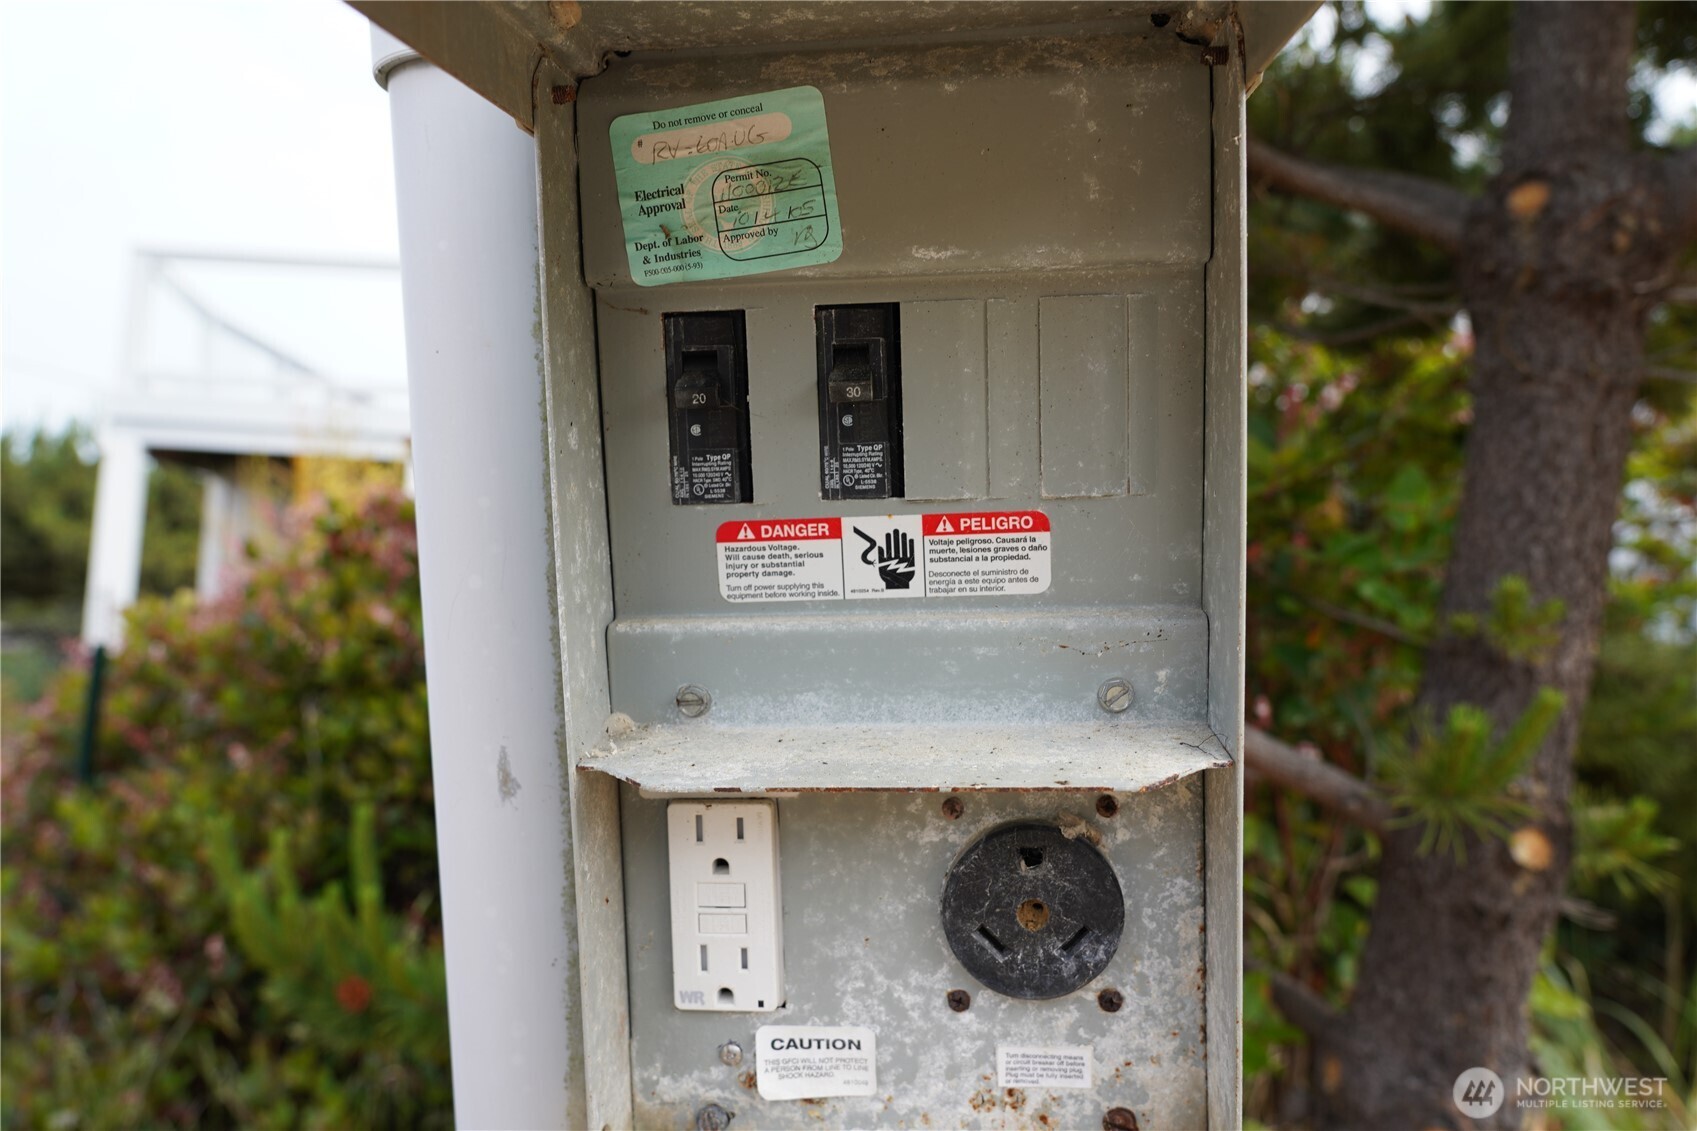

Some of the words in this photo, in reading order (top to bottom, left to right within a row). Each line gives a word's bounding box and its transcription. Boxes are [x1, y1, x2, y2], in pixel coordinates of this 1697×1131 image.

[653, 121, 666, 130] Do
[669, 118, 682, 128] not
[684, 114, 717, 125] remove
[730, 103, 763, 117] conceal
[724, 172, 754, 183] Permit
[756, 169, 772, 179] No.
[634, 184, 684, 202] Electrical
[638, 198, 686, 218] Approval
[719, 204, 739, 214] Date
[723, 230, 765, 244] Approved
[768, 228, 778, 236] by
[634, 241, 660, 252] Dept.
[662, 238, 672, 247] of
[675, 235, 704, 246] Labor
[643, 256, 651, 265] &
[654, 249, 701, 263] Industries
[846, 387, 861, 397] 30
[692, 393, 706, 405] 20
[960, 516, 1033, 531] PELIGRO
[761, 523, 829, 538] DANGER
[929, 538, 954, 547] Voltaje
[956, 538, 994, 546] peligroso.
[996, 536, 1027, 544] Causará
[768, 544, 800, 552] Voltage.
[993, 546, 1019, 554] graves
[768, 552, 792, 560] death,
[929, 555, 973, 563] substancial
[990, 554, 1031, 562] propiedad.
[726, 562, 748, 571] injury
[726, 571, 760, 579] property
[761, 570, 795, 578] damage.
[929, 570, 971, 578] Desconecte
[929, 578, 956, 587] energía
[981, 577, 1006, 585] equipo
[754, 585, 776, 593] power
[777, 583, 810, 593] supplying
[929, 586, 956, 594] trabajar
[727, 592, 764, 600] equipment
[788, 591, 816, 600] working
[679, 990, 705, 1005] WR
[771, 1038, 861, 1051] CAUTION
[1020, 1053, 1061, 1061] disconnecting
